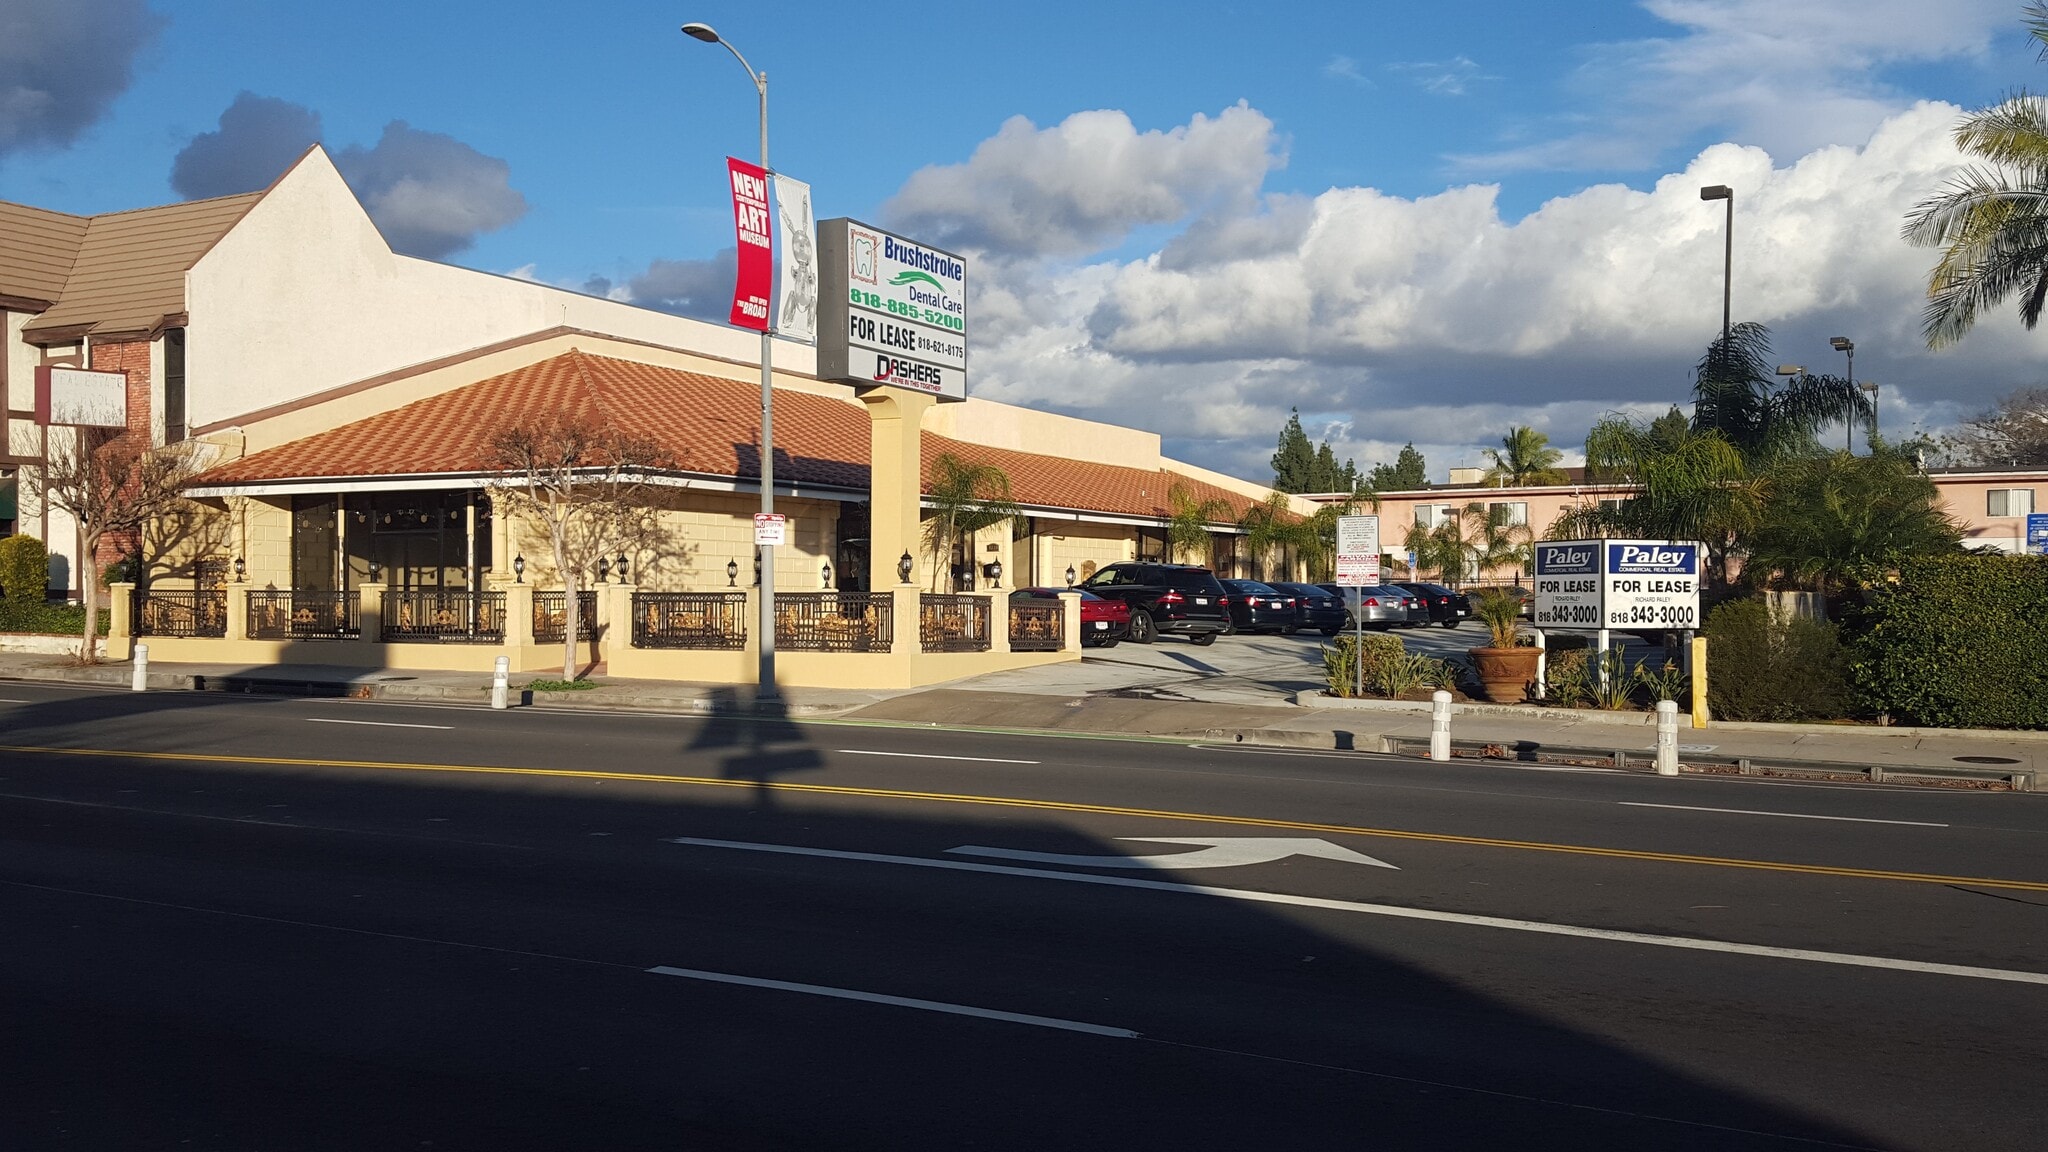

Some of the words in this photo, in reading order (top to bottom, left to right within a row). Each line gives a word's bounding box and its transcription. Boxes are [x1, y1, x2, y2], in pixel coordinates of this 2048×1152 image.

[732, 170, 764, 201] NEW
[738, 203, 768, 235] ART
[739, 228, 770, 250] MUSEUM
[885, 235, 962, 281] Brushstroke
[742, 301, 767, 319] BROAD
[850, 288, 963, 331] 818-885-5200
[909, 285, 940, 308] Dental
[942, 295, 962, 314] Care
[850, 315, 875, 342] FOR
[880, 322, 916, 351] LEASE
[917, 336, 963, 358] 818-621-8175
[876, 354, 941, 385] DASHERS
[1545, 547, 1592, 567] Paley
[1620, 546, 1686, 567] Paley
[1540, 580, 1560, 593] FOR
[1564, 580, 1596, 593] LEASE
[1612, 580, 1641, 593] FOR
[1647, 580, 1692, 593] LEASE
[1538, 611, 1551, 622] 818
[1552, 605, 1598, 623] 343-3000
[1610, 612, 1629, 623] 818
[1631, 605, 1694, 624] 343-3000
